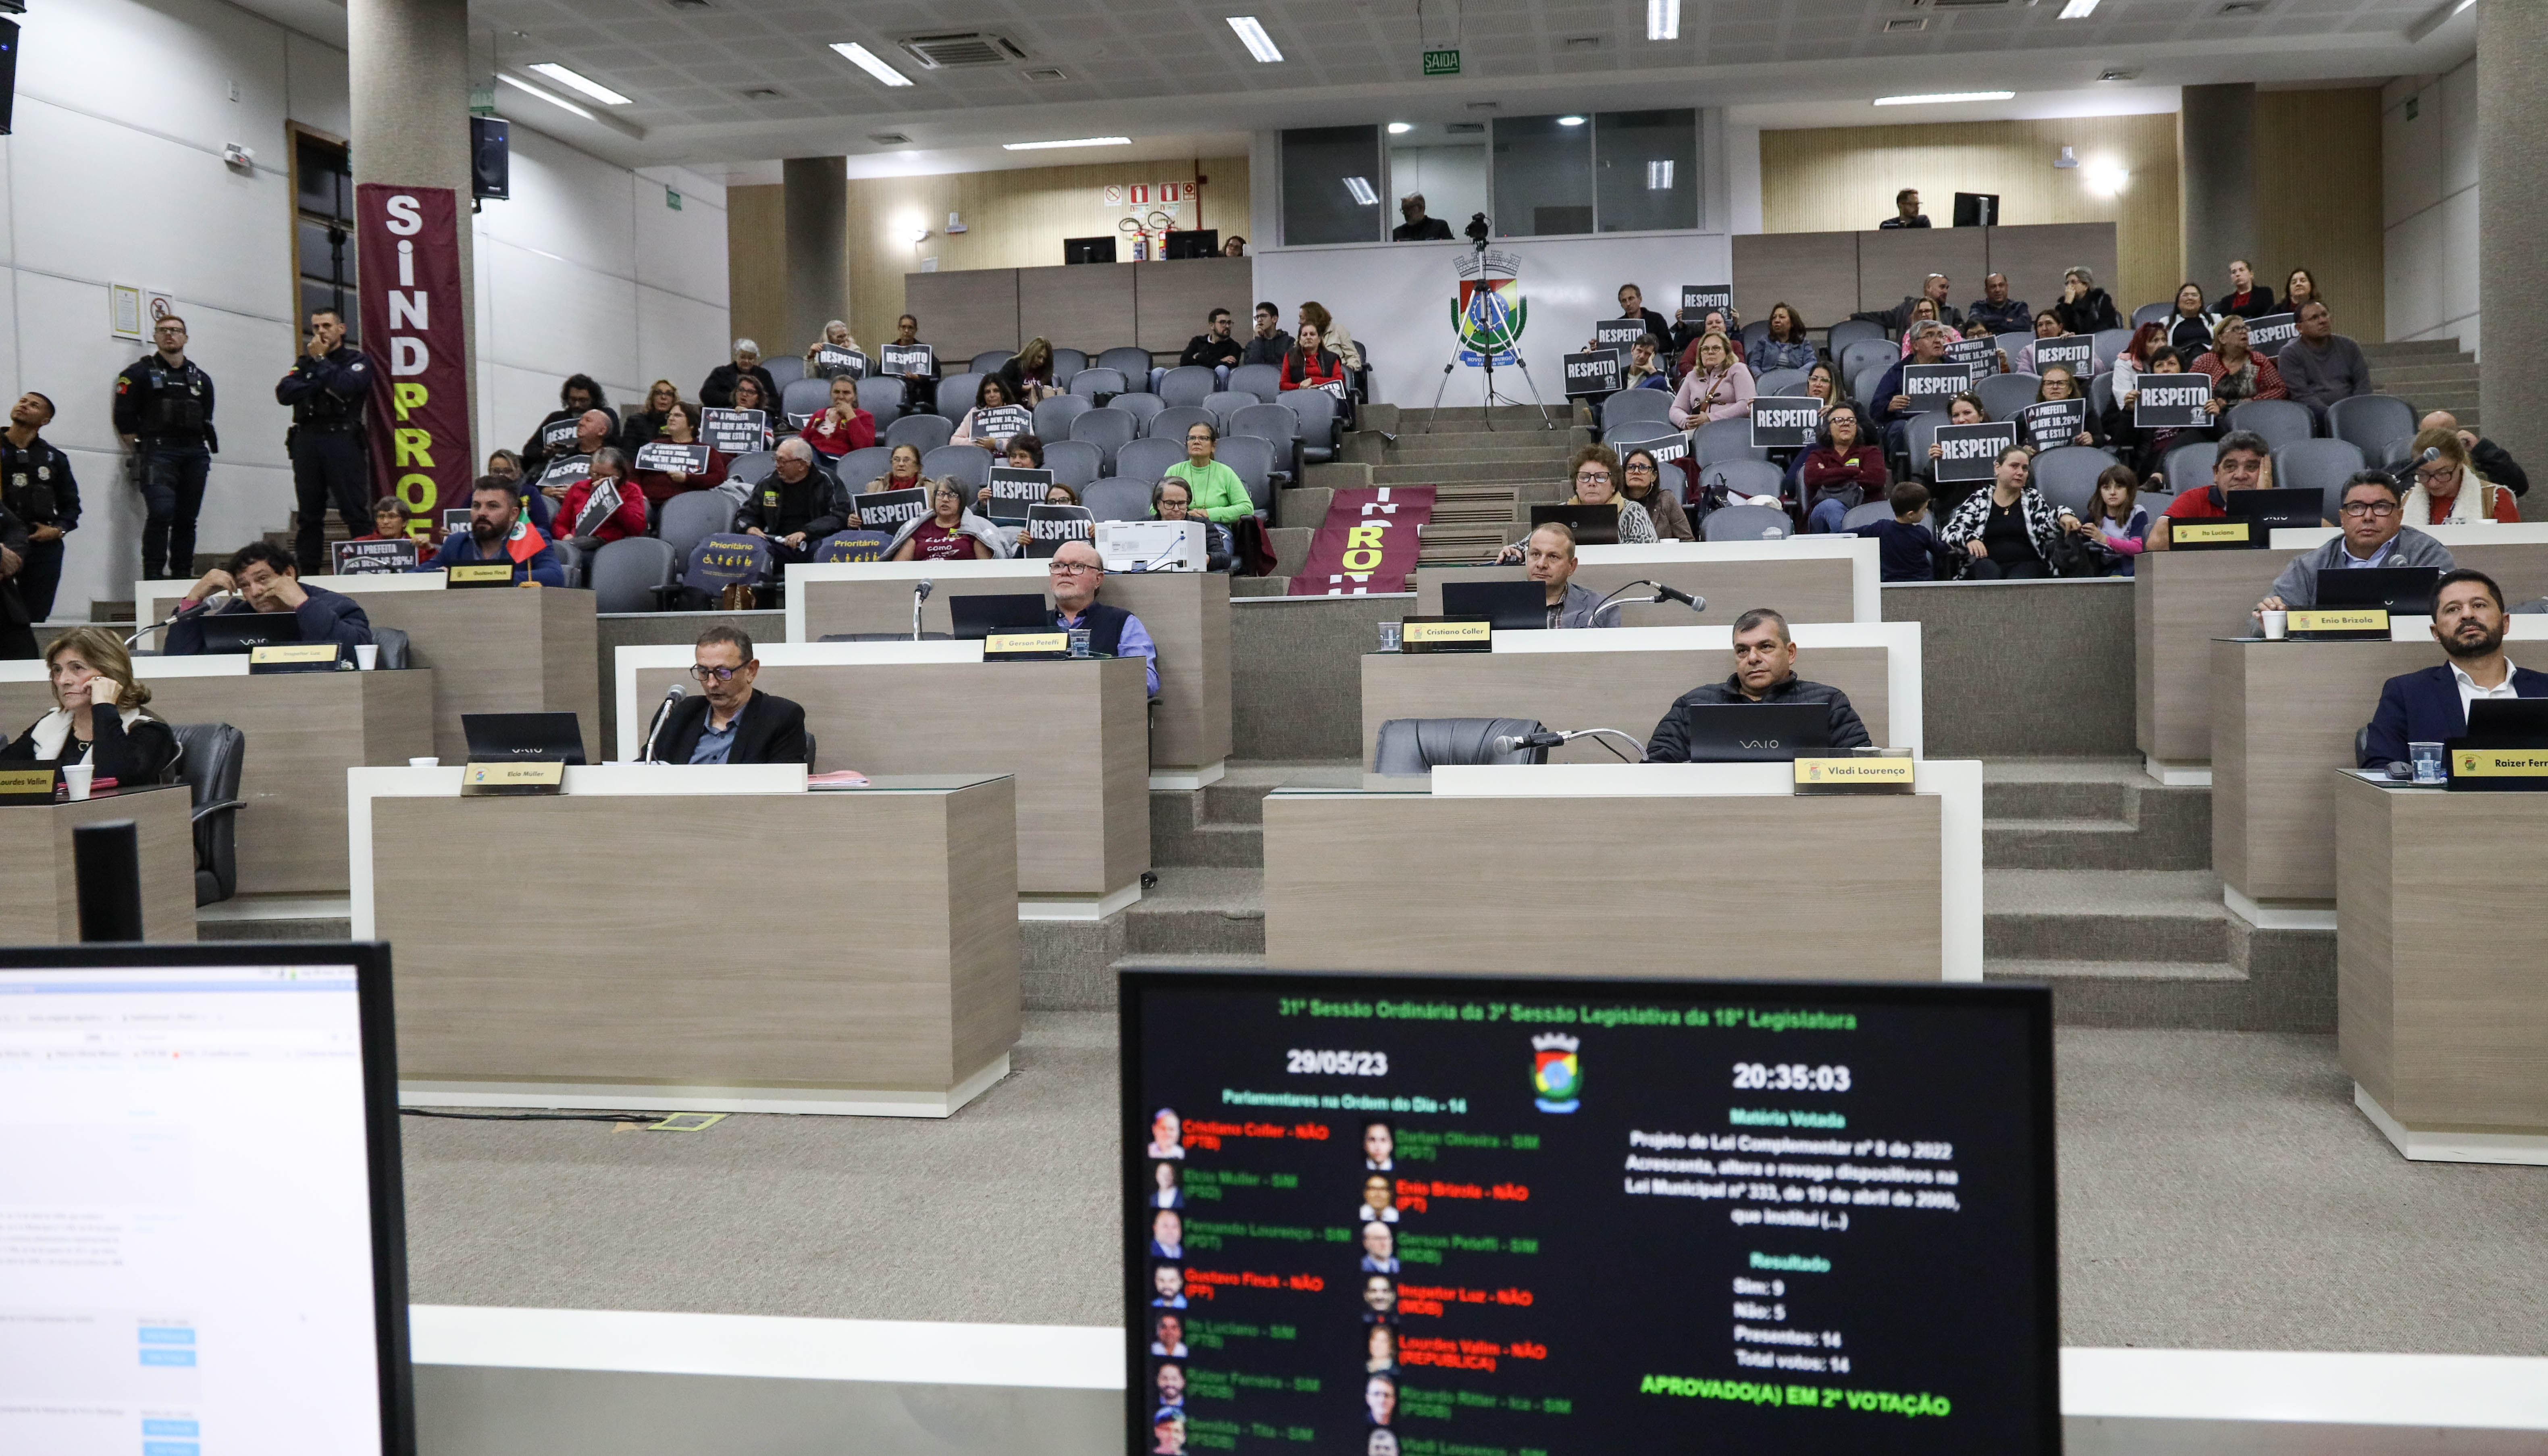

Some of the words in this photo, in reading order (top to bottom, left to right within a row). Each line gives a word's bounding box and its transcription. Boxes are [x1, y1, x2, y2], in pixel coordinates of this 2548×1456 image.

[1685, 293, 1728, 308] RESPEITO
[1599, 328, 1645, 343] RESPEITO
[2248, 322, 2299, 345] RESPEITO
[1960, 341, 1984, 351] PREFEITA
[2038, 345, 2090, 363] RESPEITO
[820, 350, 863, 369] RESPEITO
[886, 352, 928, 364] RESPEITO
[1568, 360, 1616, 378] RESPEITO
[1909, 376, 1968, 394] RESPEITO
[2141, 387, 2208, 406] RESPEITO
[992, 408, 1017, 416] PREFEITA
[1757, 409, 1818, 427] RESPEITO
[2040, 404, 2067, 416] PREFEITA
[1001, 423, 1015, 431] ESTÁ
[2049, 427, 2066, 438] ESTÁ
[2067, 428, 2072, 436] O
[992, 480, 1048, 501] RESPEITO
[861, 501, 923, 525] RESPEITO
[1030, 519, 1092, 540] RESPEITO
[363, 543, 397, 555] PREFEITA
[709, 541, 753, 550] Prioritário
[834, 539, 880, 547] Prioritário
[1739, 739, 1779, 749] VAIO
[1828, 766, 1855, 775] Vladi
[1858, 766, 1905, 777] Lourenço
[2495, 759, 2525, 768] Raizer
[2528, 759, 2548, 768] Ferr
[1310, 998, 1372, 1018] Sessão
[1375, 1000, 1458, 1021] Ordinária
[1460, 1002, 1484, 1021] da
[1510, 1003, 1577, 1023] Sessão
[1580, 1005, 1681, 1028] Legislativa
[1684, 1006, 1709, 1026] da
[1747, 1009, 1857, 1032] Legislatura
[1287, 1048, 1388, 1076] 29/05/23
[1732, 1062, 1851, 1092] 20:35:03
[1629, 1129, 1686, 1151] Projeto
[1688, 1132, 1709, 1150] de
[1710, 1134, 1736, 1151] Lei
[1737, 1134, 1852, 1156] Complementar
[1888, 1140, 1910, 1158] de
[1624, 1177, 1650, 1194] Lei
[1782, 1184, 1804, 1202] de
[1828, 1186, 1850, 1204] de
[1891, 1190, 1913, 1207] de
[1749, 1250, 1831, 1272] Resultado
[1733, 1277, 1771, 1296] Sim:
[1733, 1301, 1772, 1321] Não:
[1734, 1348, 1774, 1368] Total
[1640, 1373, 1782, 1407] APROVADO(A)
[1786, 1384, 1819, 1406] EM
[1845, 1388, 1951, 1417] VOTAÇÃO
